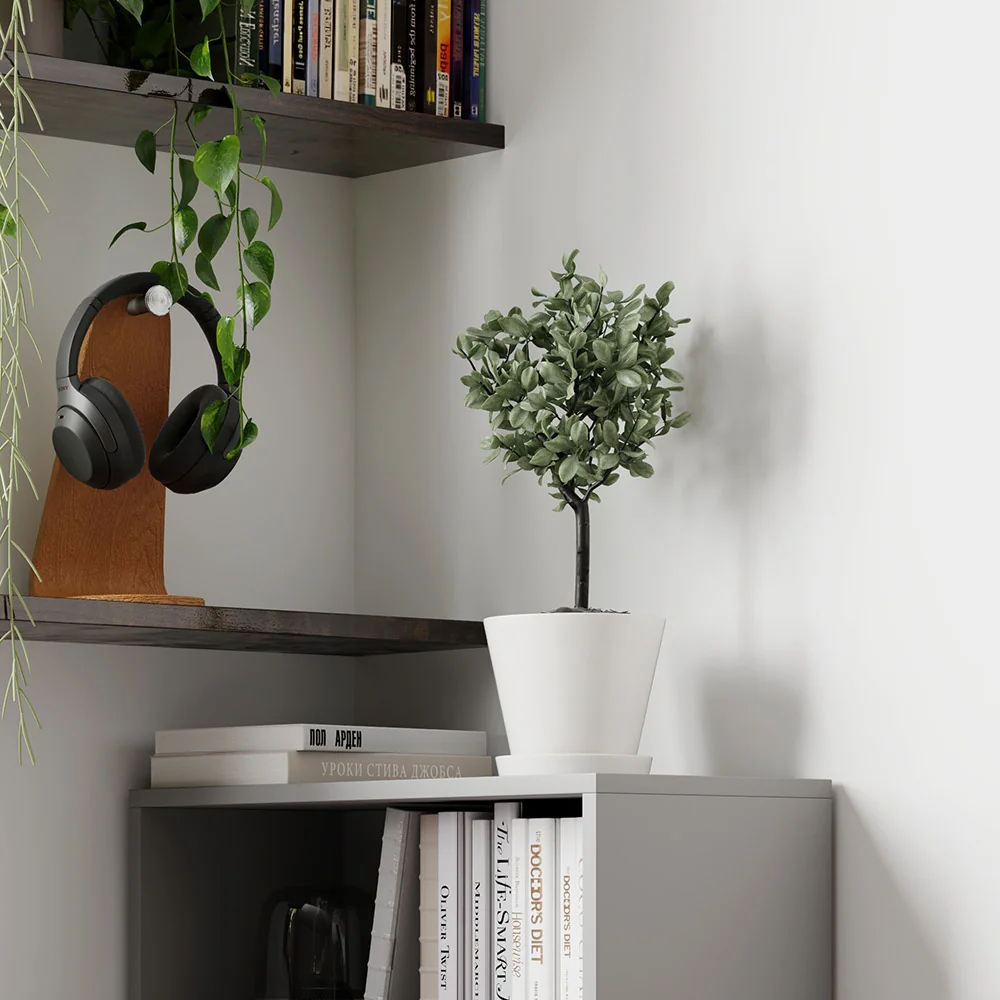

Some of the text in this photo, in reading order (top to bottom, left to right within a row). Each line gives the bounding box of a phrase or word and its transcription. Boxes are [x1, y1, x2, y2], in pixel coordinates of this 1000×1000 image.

[309, 728, 362, 750] ПОЛ АРДЕН
[321, 761, 462, 780] УРОКИ СТИВА ДЖОБСА
[440, 885, 450, 990] OLIVER TWIST
[512, 912, 523, 978] Housewise
[530, 929, 544, 964] DIET
[563, 934, 571, 958] DIET
